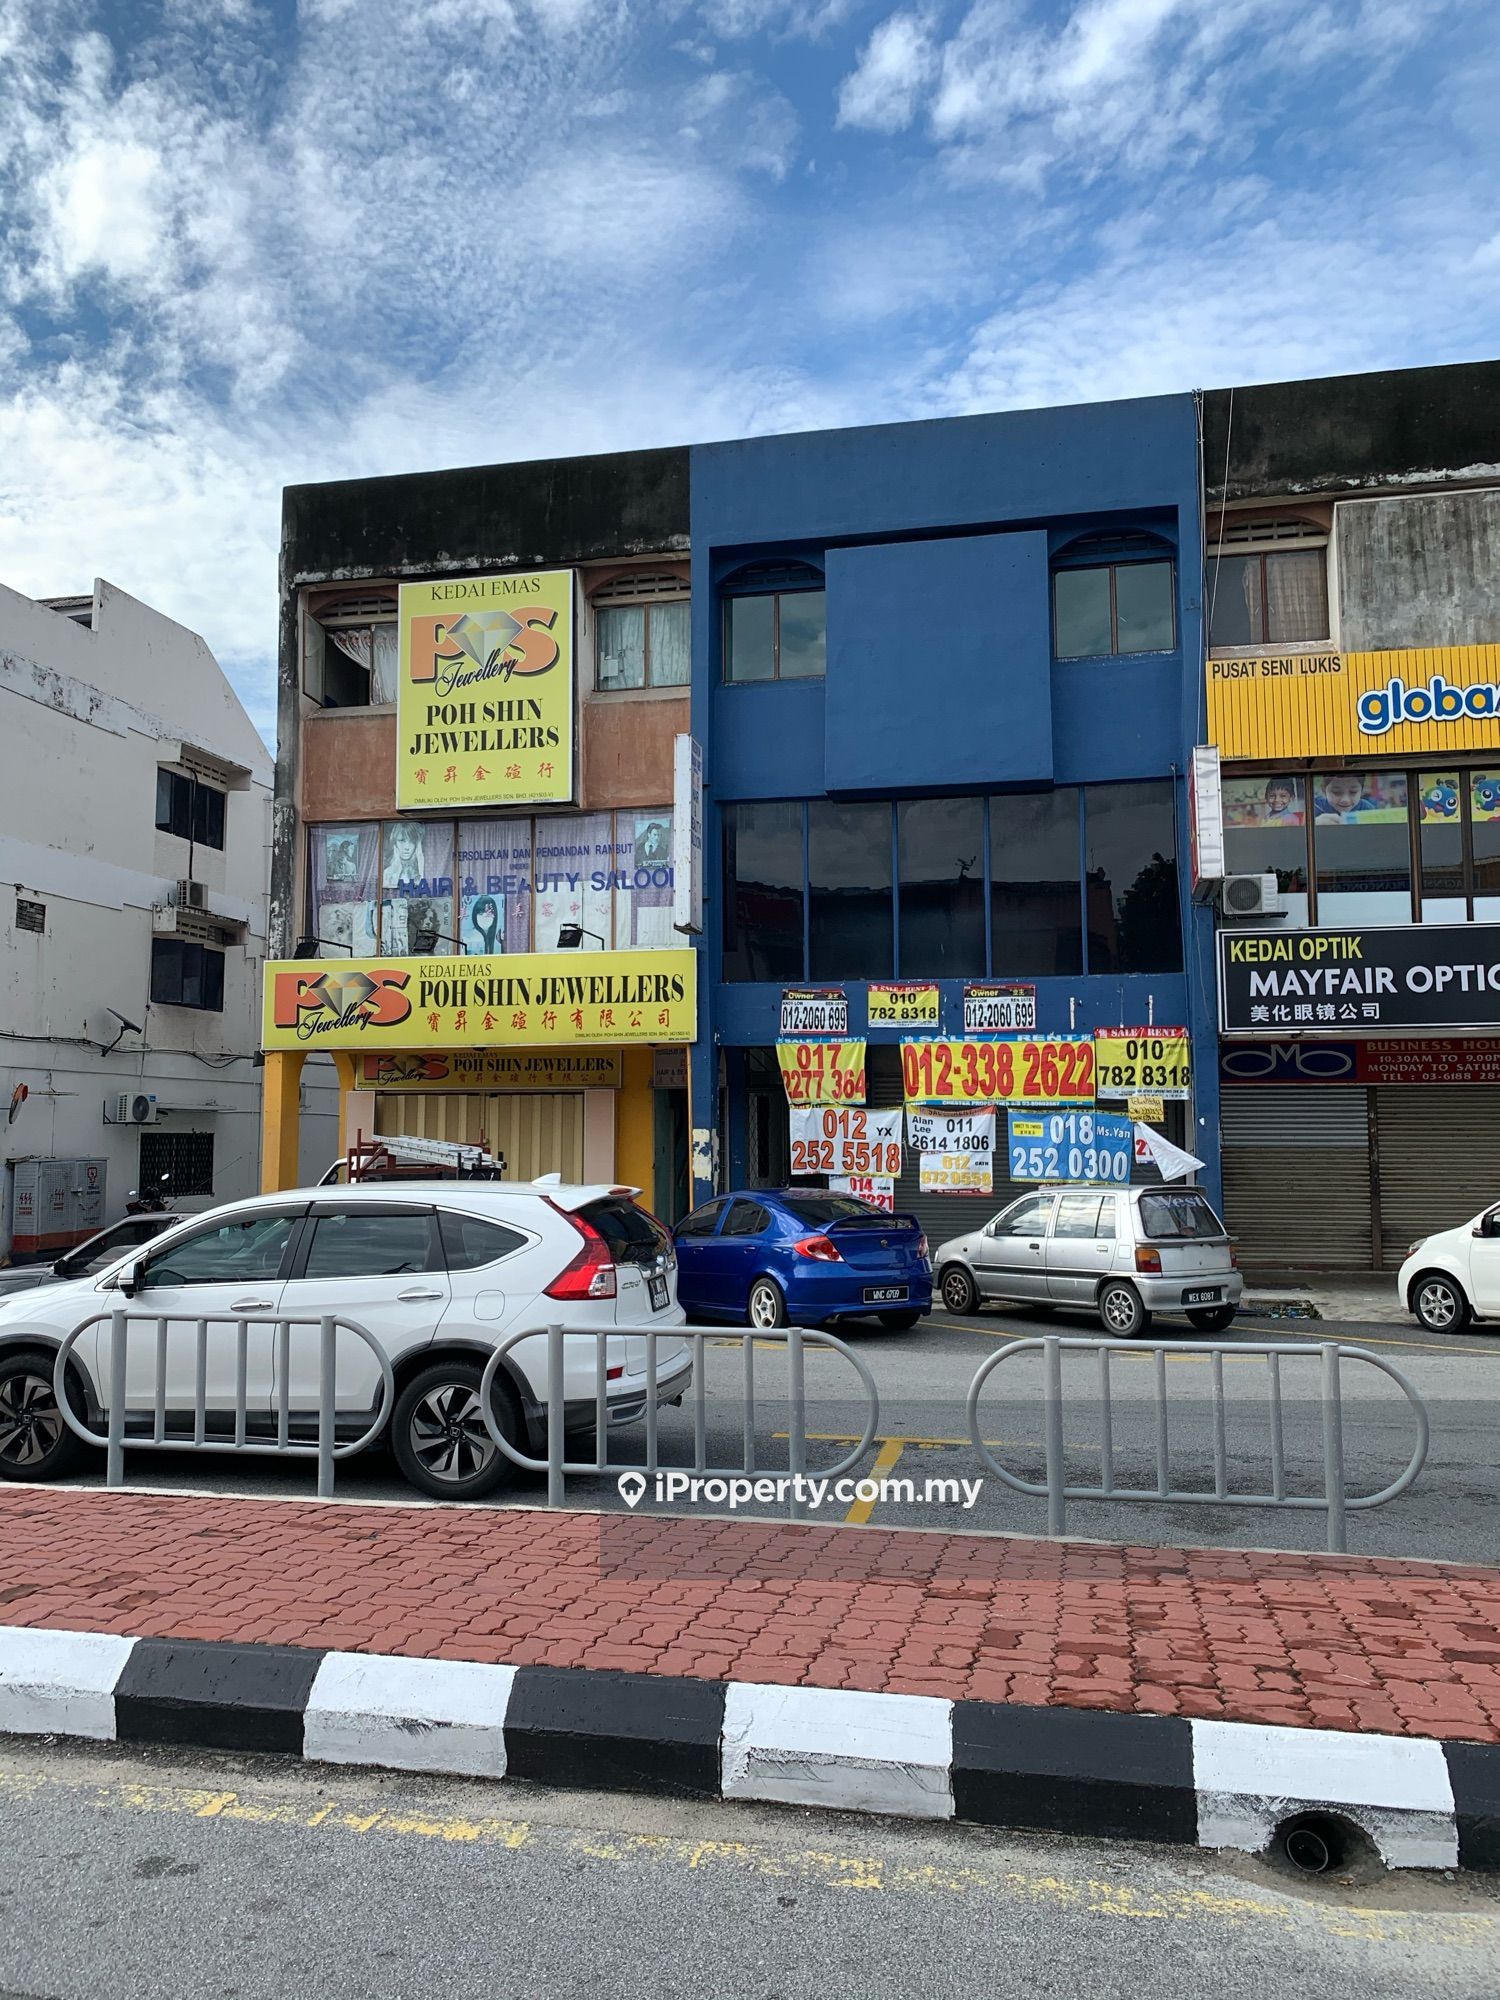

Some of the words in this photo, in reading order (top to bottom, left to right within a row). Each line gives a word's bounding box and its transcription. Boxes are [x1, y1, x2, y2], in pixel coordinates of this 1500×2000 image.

[431, 583, 486, 600] KEDAI
[492, 578, 541, 596] EMAS
[434, 648, 519, 697] Jewellery
[1213, 661, 1256, 680] PUSAT
[1262, 659, 1293, 676] SENI
[1301, 656, 1341, 675] LUKIS
[426, 702, 476, 726] POH
[482, 698, 543, 723] SHIN
[1359, 677, 1500, 732] globa
[409, 725, 559, 755] JEWELLERS
[513, 847, 531, 859] DAN
[536, 845, 589, 858] PENDANDAN
[398, 877, 453, 898] HAIR
[462, 876, 478, 897] &
[486, 872, 580, 895] BEAUTY
[1230, 939, 1294, 962] KEDAI
[1299, 936, 1363, 961] OPTIK
[419, 965, 456, 978] KEDAI
[459, 963, 492, 977] EMAS
[419, 979, 467, 1008] POH
[473, 977, 531, 1007] SHIN
[535, 973, 684, 1006] JEWELLERS
[1249, 966, 1398, 997] MAYFAIR
[788, 992, 815, 1000] Owner
[890, 993, 916, 1004] 010
[971, 989, 998, 997] Owner
[297, 1002, 374, 1040] Jewellery
[782, 1006, 825, 1030] 012-2060
[829, 1006, 846, 1030] 699
[870, 1007, 895, 1019] 782
[901, 1007, 937, 1019] 8318
[966, 1003, 1011, 1028] 012-2060
[1015, 1003, 1034, 1027] 699
[1250, 1002, 1380, 1022] 美化眼镜公司
[1017, 1034, 1077, 1042] RENT
[1111, 1029, 1137, 1037] SALE
[1147, 1028, 1177, 1037] RENT
[1126, 1040, 1164, 1060] 010
[1366, 1041, 1452, 1051] BUSINESS
[453, 1059, 483, 1072] POH
[486, 1058, 522, 1072] SHIN
[524, 1057, 615, 1072] JEWELLERS
[796, 1044, 842, 1070] 017
[1380, 1055, 1433, 1063] 10.30AM
[378, 1067, 426, 1086] Jewellery
[903, 1043, 1014, 1097] 012-338
[1022, 1043, 1095, 1096] 2622
[1098, 1066, 1136, 1086] 782
[1142, 1065, 1190, 1086] 8318
[1368, 1064, 1424, 1072] MONDAY
[1381, 1073, 1404, 1081] TEL
[1422, 1072, 1472, 1080] 03-6188
[782, 1070, 825, 1099] 2277
[831, 1069, 866, 1099] 364
[822, 1109, 867, 1140] 012
[912, 1116, 933, 1125] Alan
[914, 1125, 931, 1133] Lee
[946, 1118, 973, 1133] 011
[1050, 1115, 1094, 1145] 018
[876, 1127, 893, 1137] YX
[912, 1134, 948, 1150] 2614
[953, 1135, 989, 1150] 1806
[1136, 1139, 1153, 1155] 2
[792, 1140, 834, 1170] 252
[842, 1141, 900, 1173] 5518
[942, 1155, 971, 1169] 012
[1012, 1147, 1060, 1177] 252
[1068, 1147, 1128, 1181] 0300
[850, 1177, 873, 1193] 014
[1188, 1293, 1200, 1302] WEX
